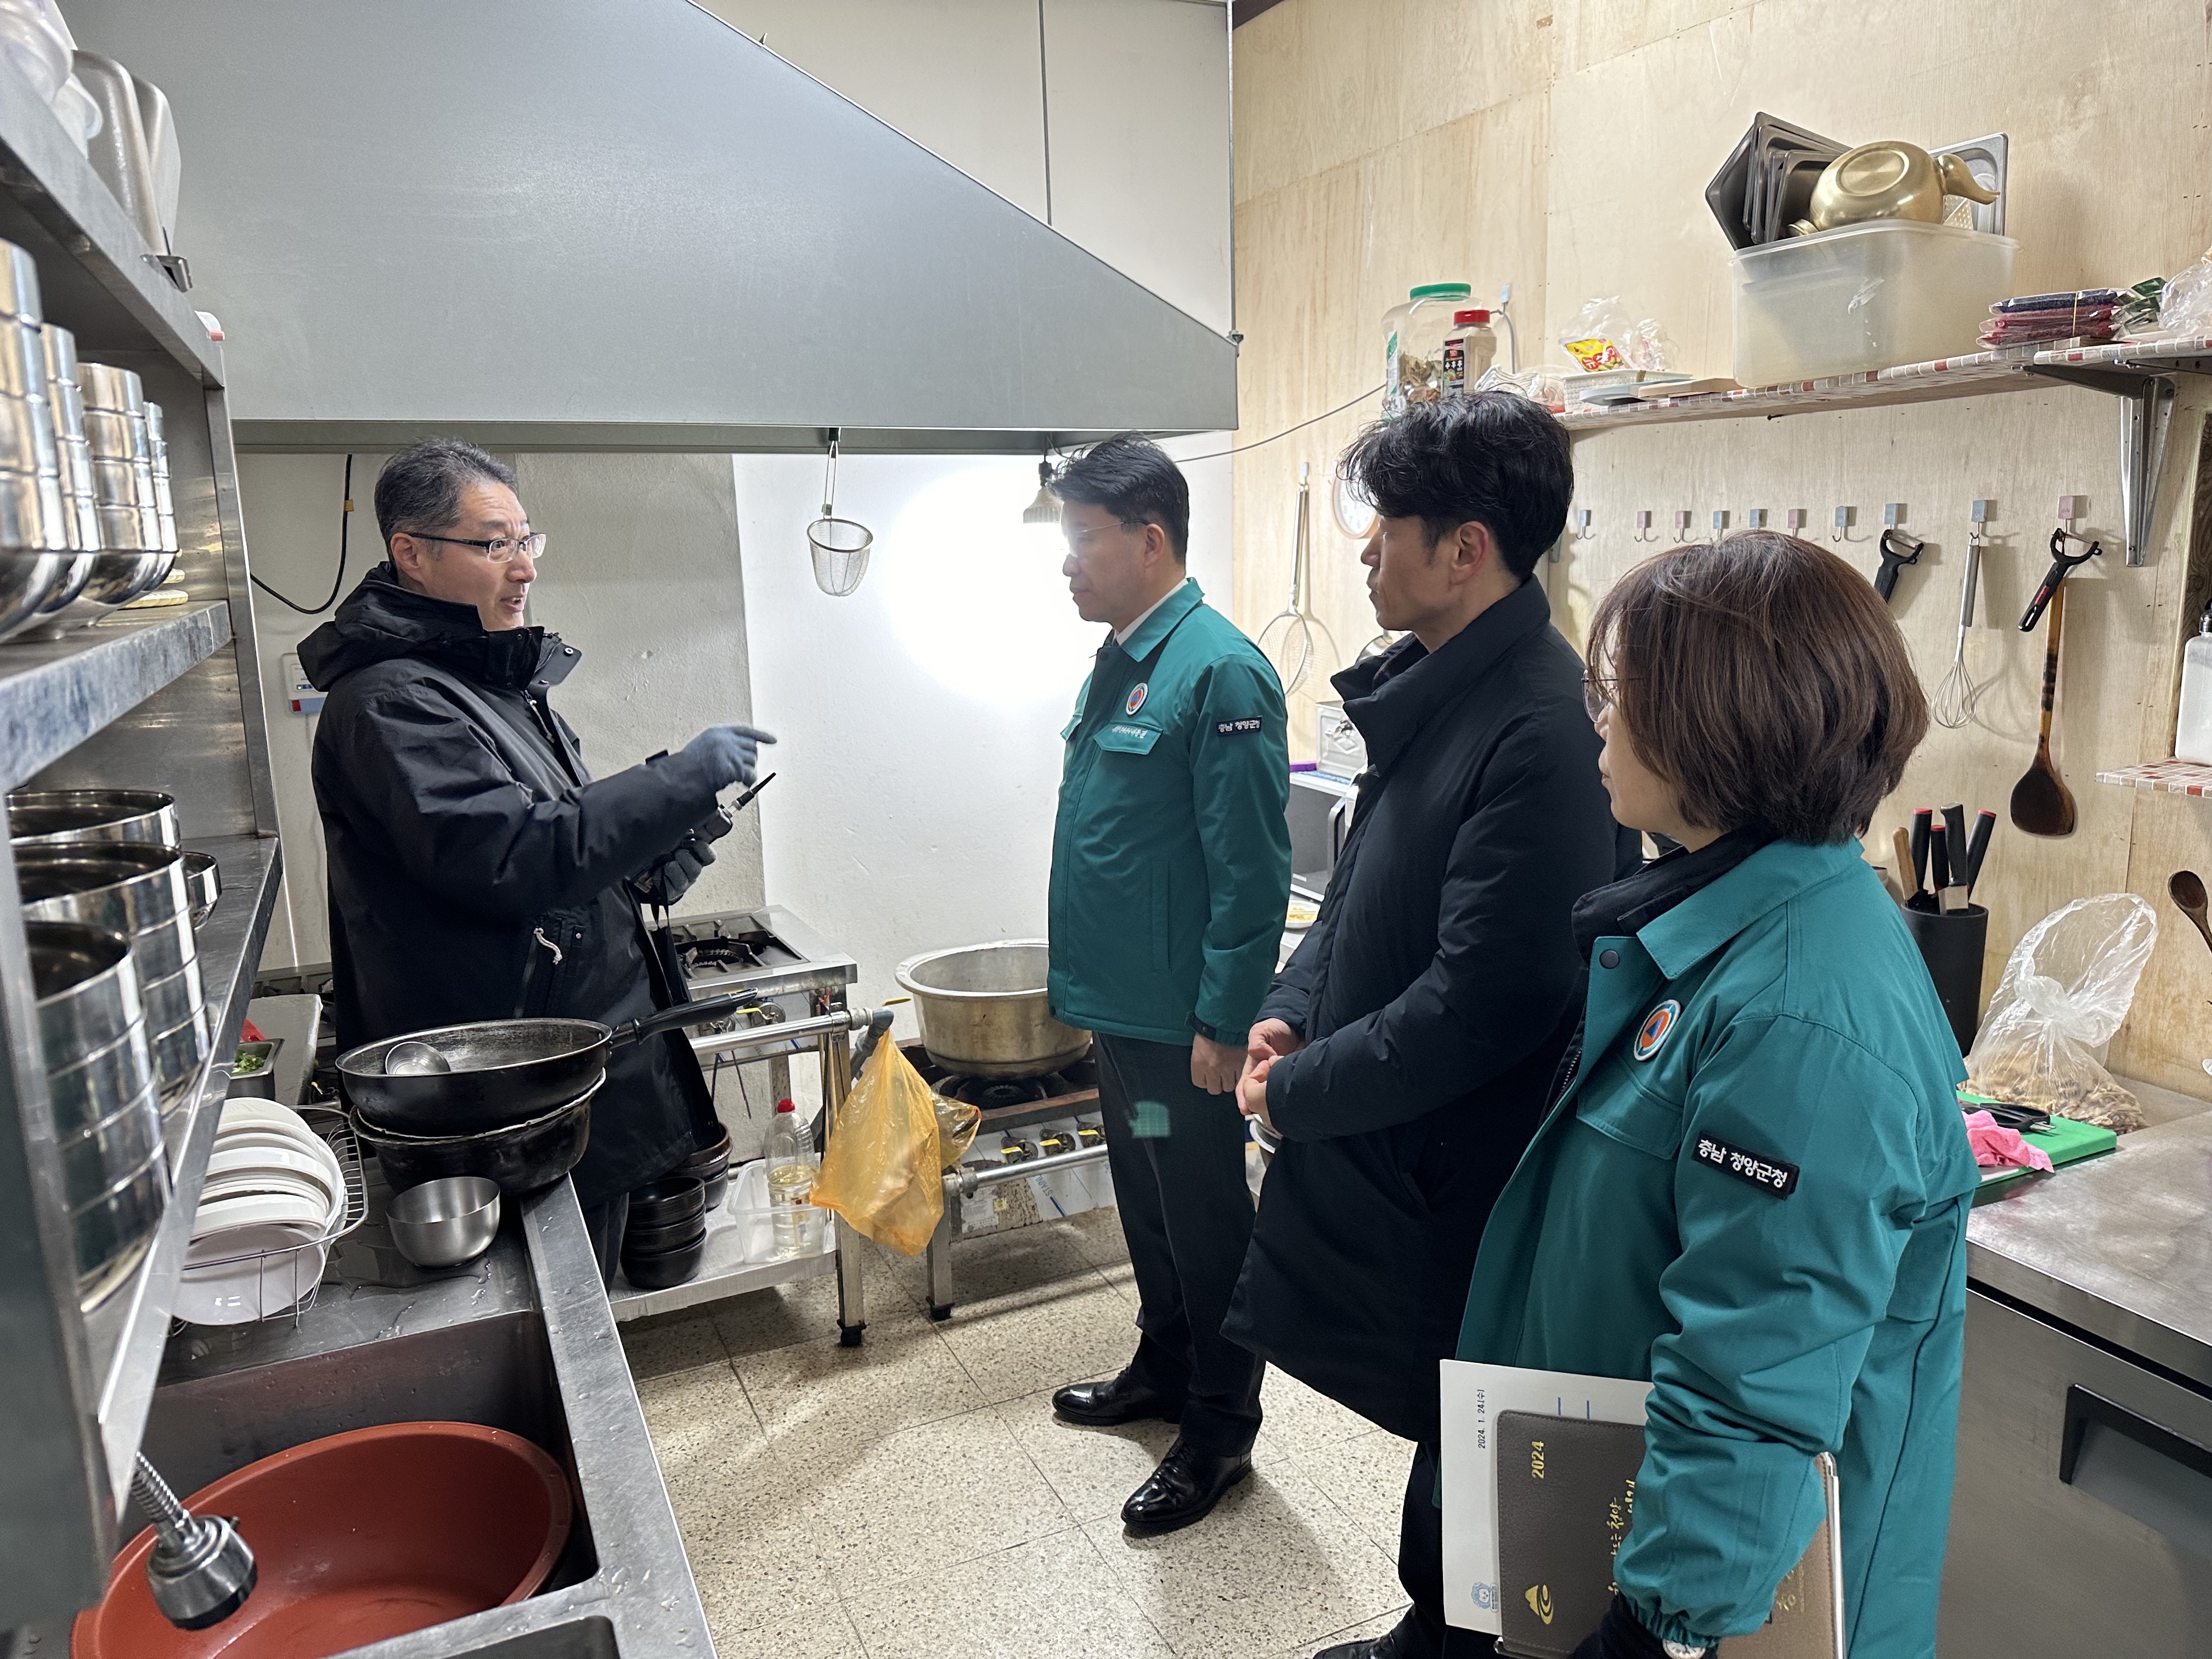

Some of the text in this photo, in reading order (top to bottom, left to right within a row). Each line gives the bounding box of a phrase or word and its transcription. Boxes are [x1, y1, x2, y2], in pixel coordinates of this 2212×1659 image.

[1218, 723, 1233, 732] 충남
[1699, 1139, 1788, 1188] 충남 청양군청
[1531, 1441, 1544, 1479] 2024
